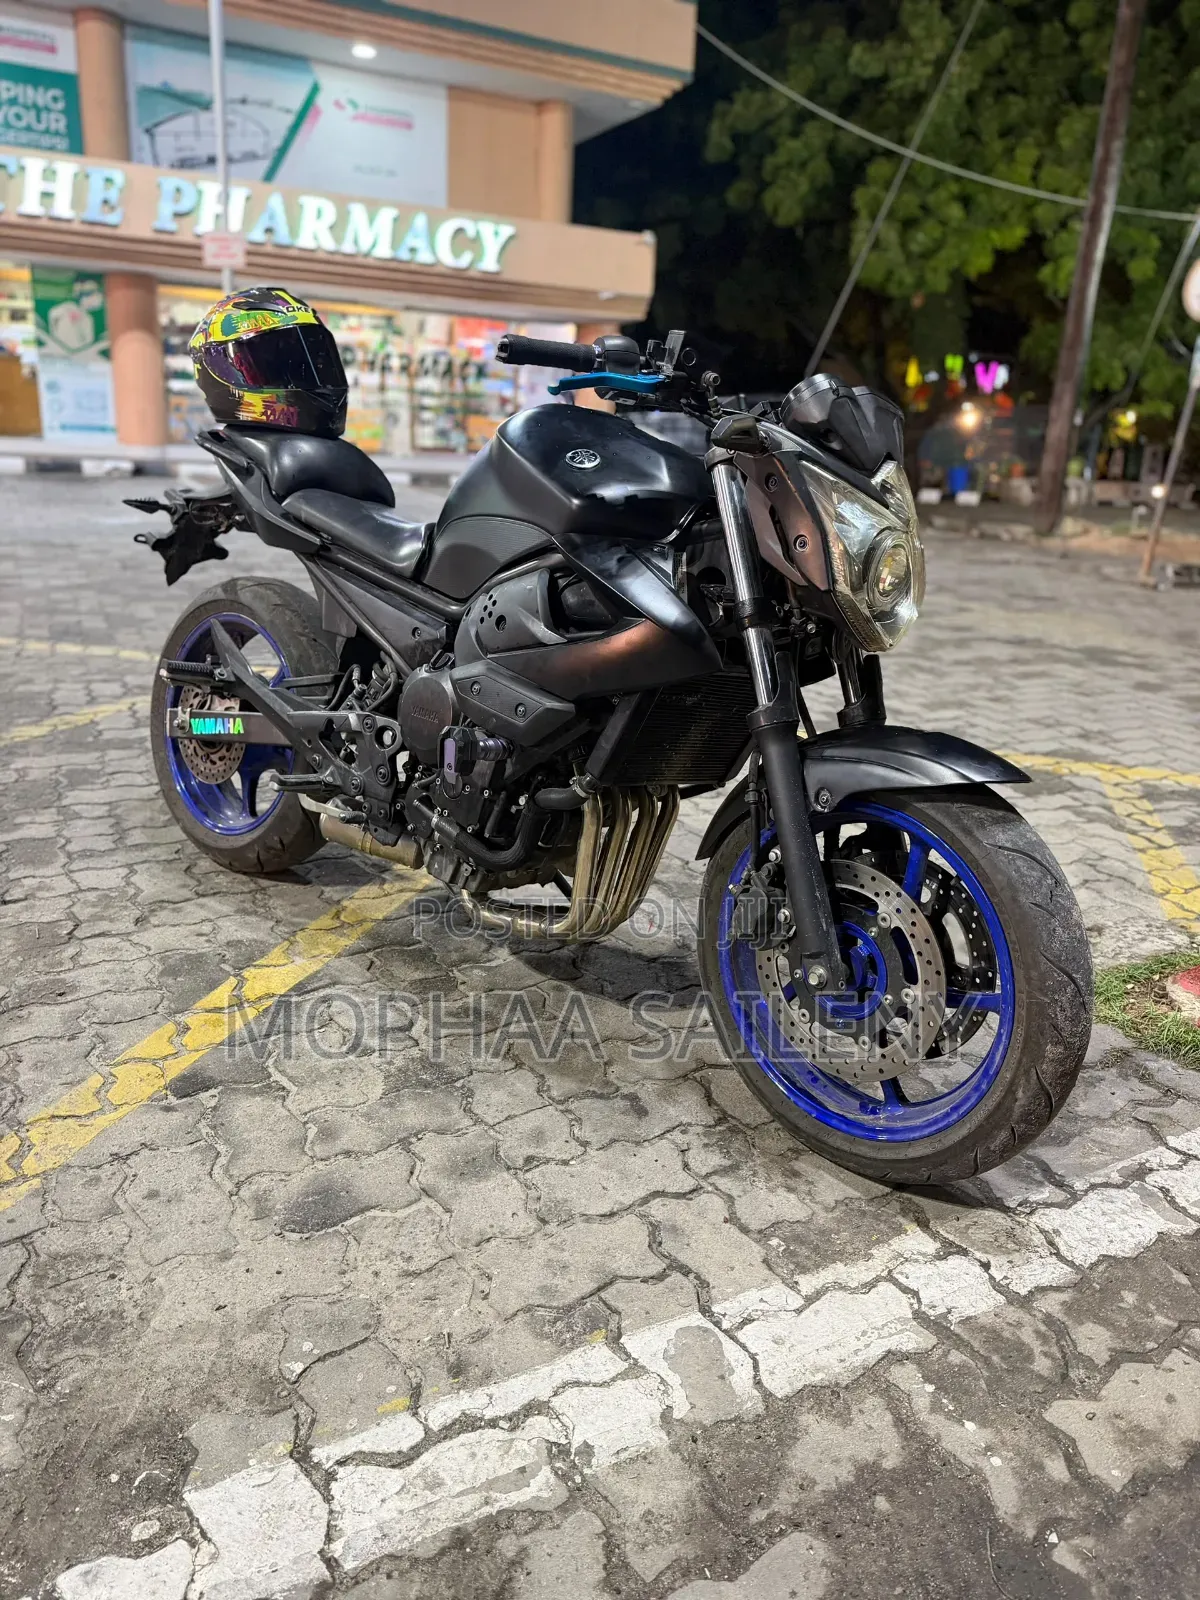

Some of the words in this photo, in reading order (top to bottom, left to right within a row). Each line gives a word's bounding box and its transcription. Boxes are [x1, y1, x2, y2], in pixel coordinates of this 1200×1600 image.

[153, 176, 516, 273] PHARMACY
[411, 705, 439, 724] YAMAHA
[190, 717, 245, 735] YAMAHA
